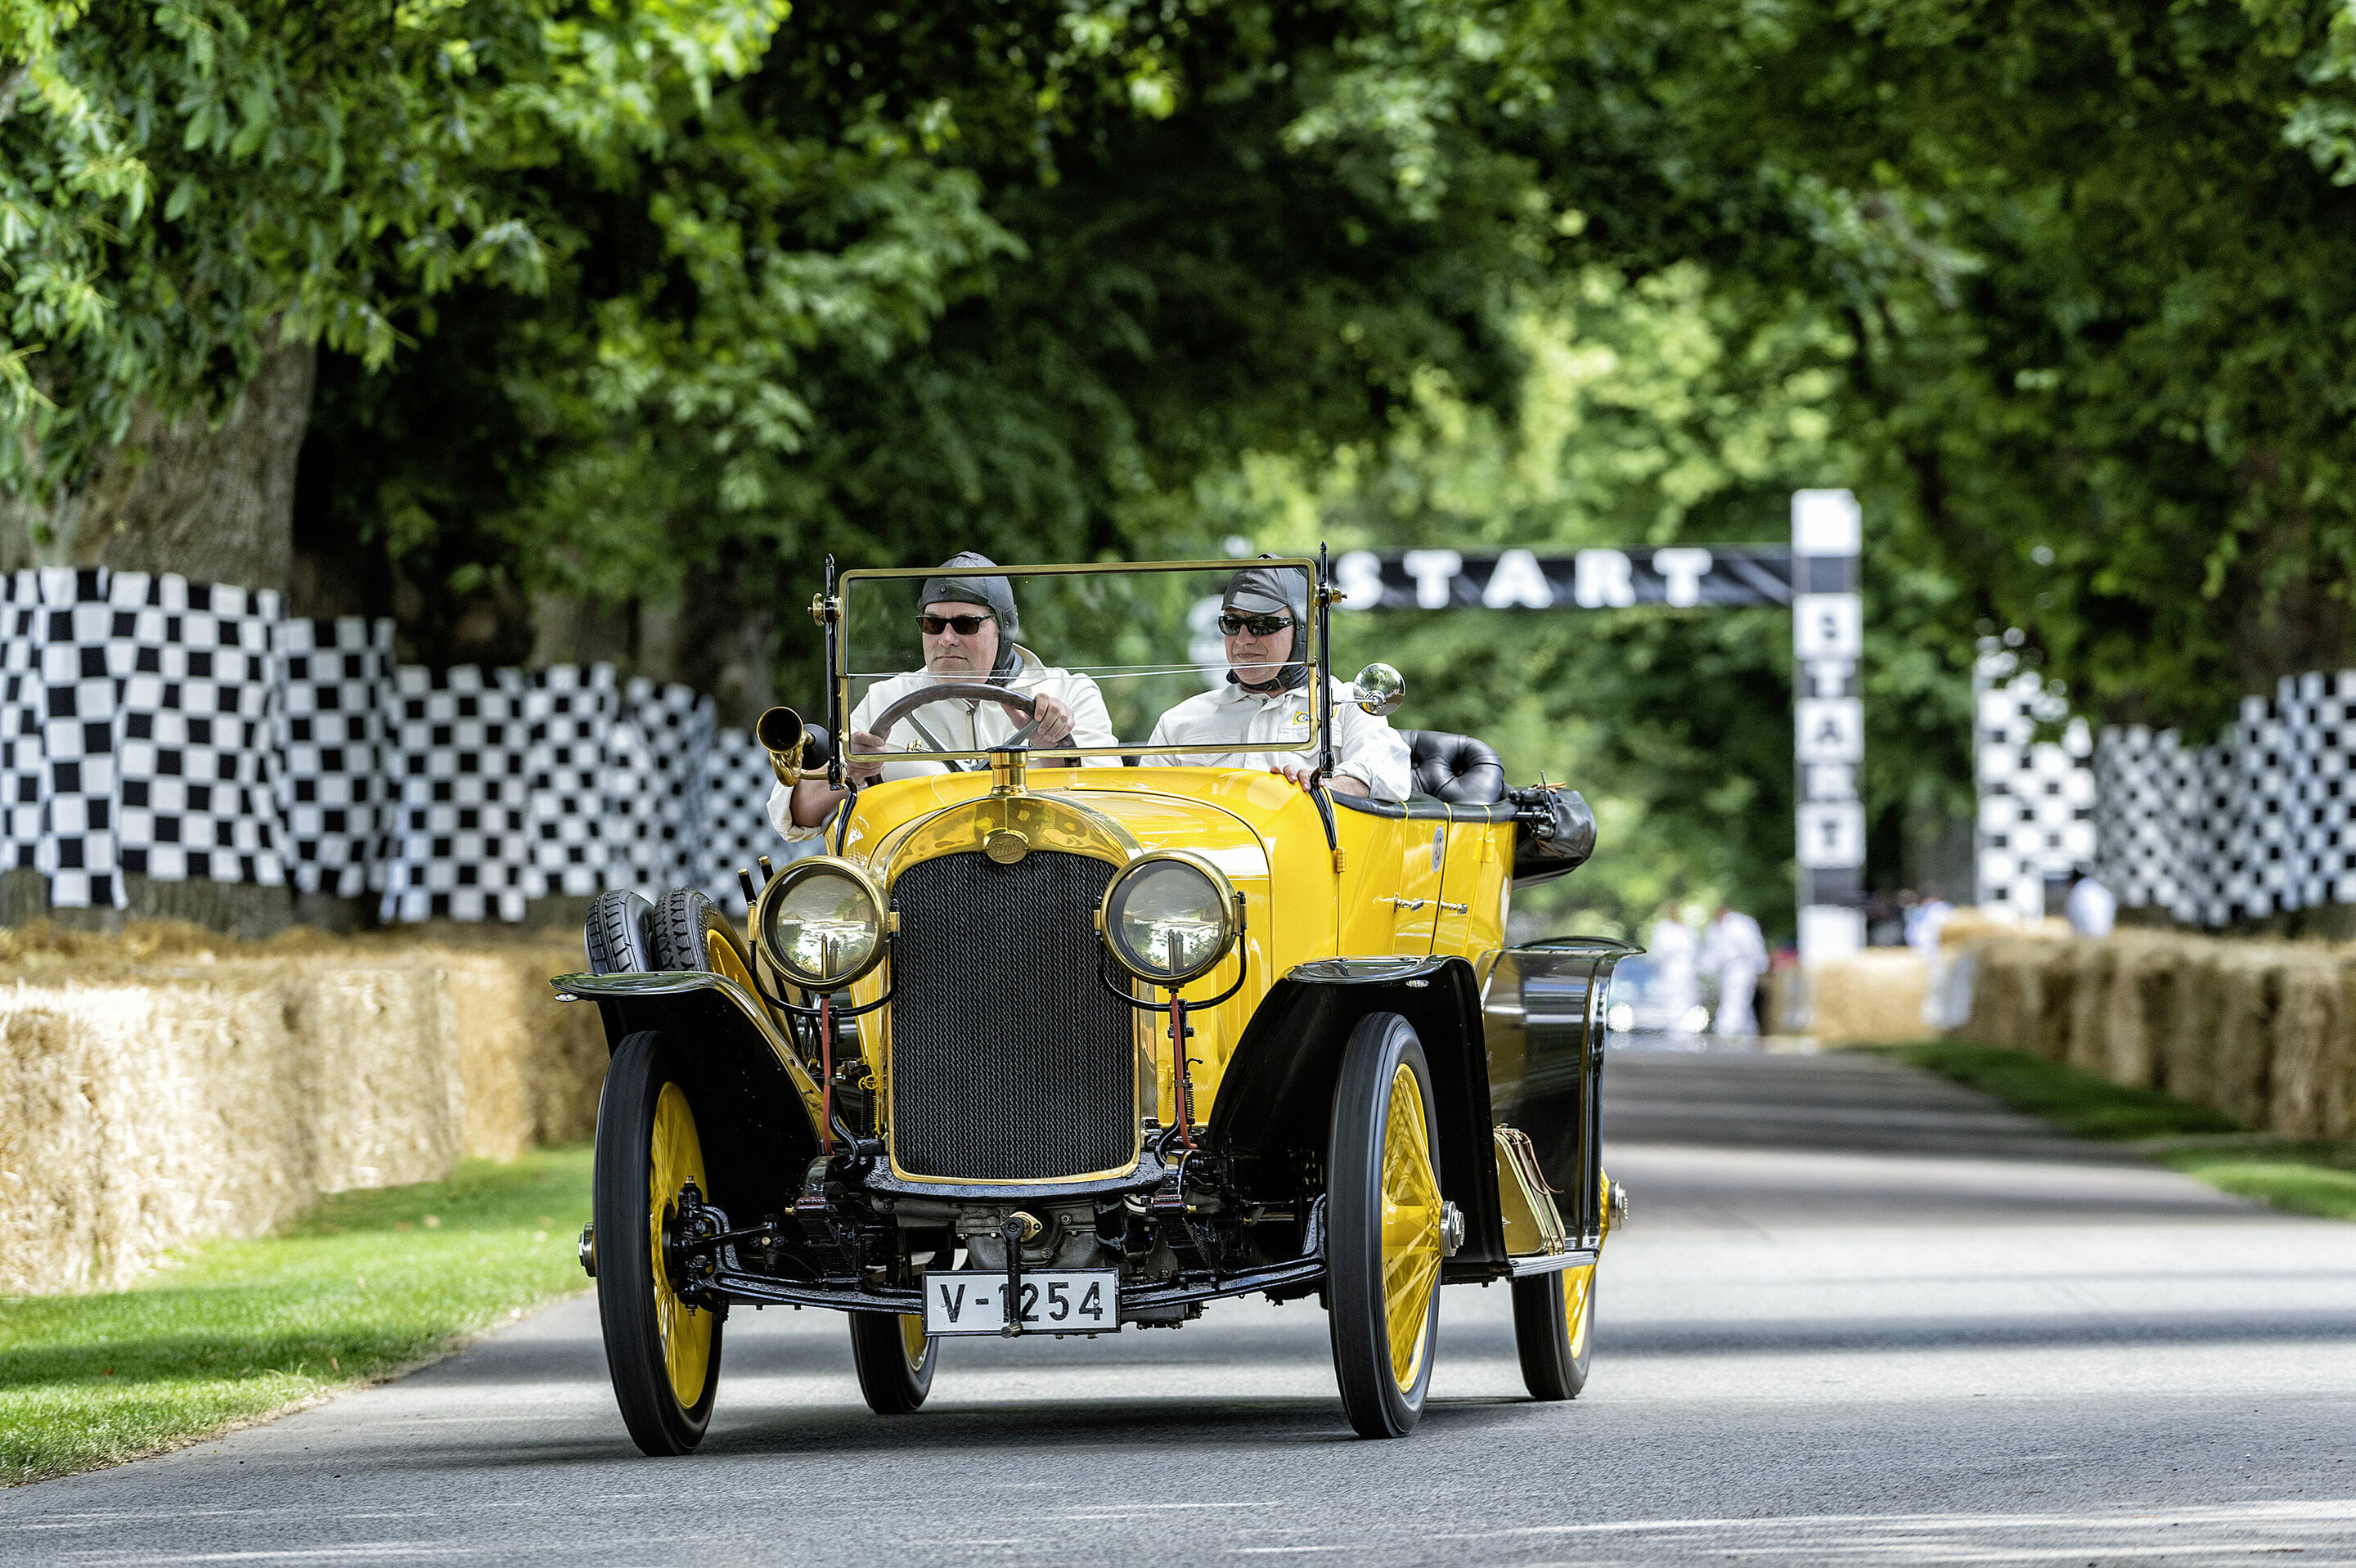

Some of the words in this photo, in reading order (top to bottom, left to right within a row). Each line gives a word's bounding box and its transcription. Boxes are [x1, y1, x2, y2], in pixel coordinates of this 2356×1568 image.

[1333, 547, 1713, 610] START
[1803, 613, 1857, 849] START
[940, 1281, 1104, 1323] V-1254
